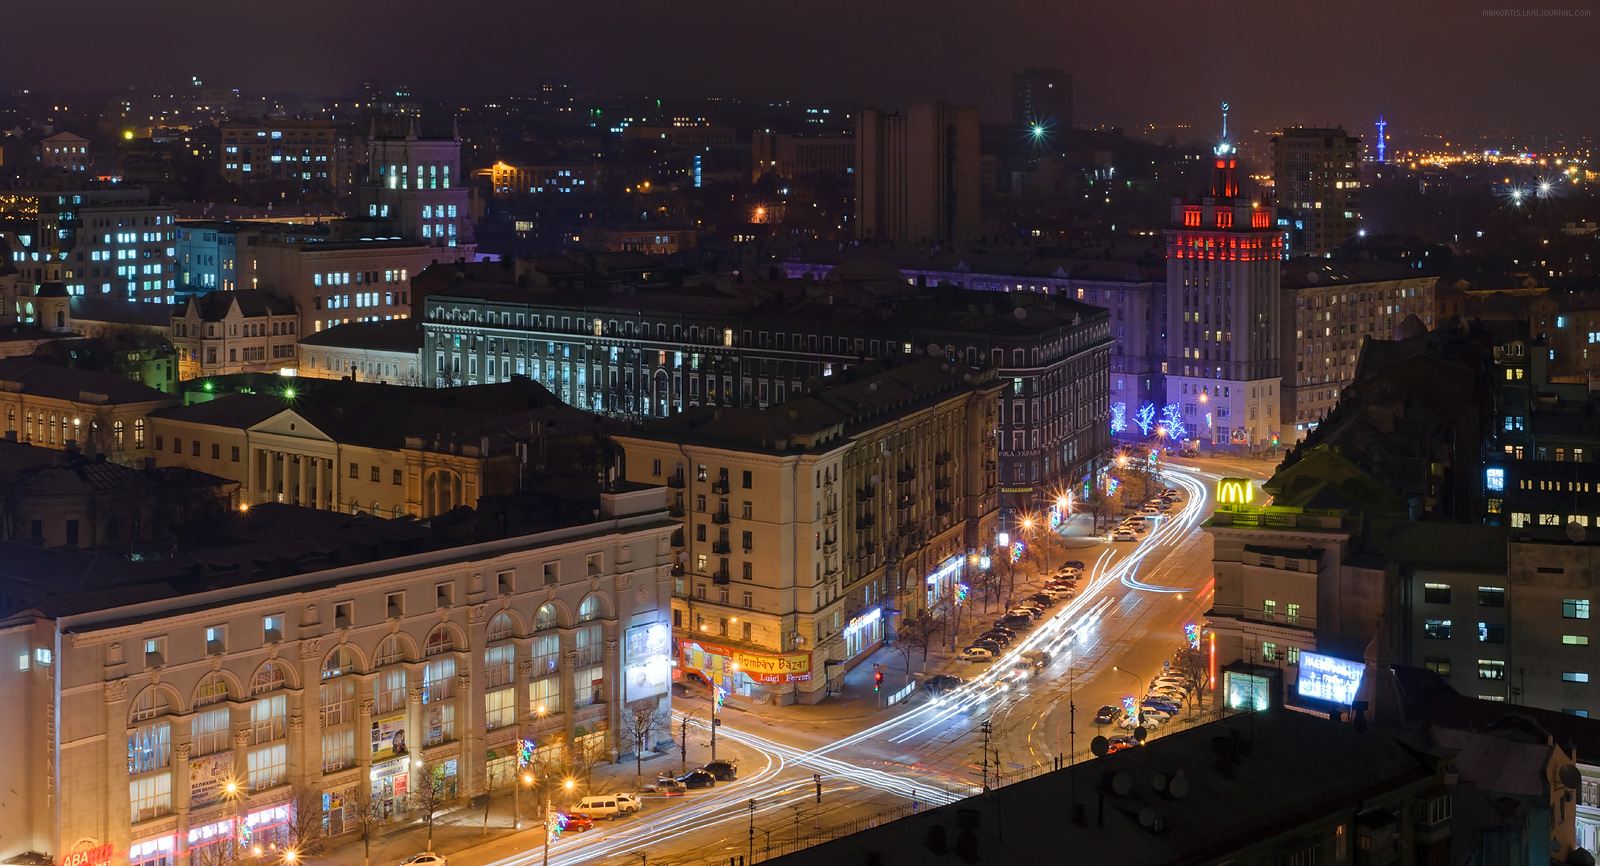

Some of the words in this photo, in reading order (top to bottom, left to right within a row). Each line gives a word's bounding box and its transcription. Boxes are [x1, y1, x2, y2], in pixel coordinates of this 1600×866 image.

[739, 653, 775, 672] Bombay
[778, 658, 807, 671] Bazar
[760, 673, 780, 685] Luigi
[785, 671, 811, 683] Ferrari
[63, 844, 114, 866] АВАНТИ
